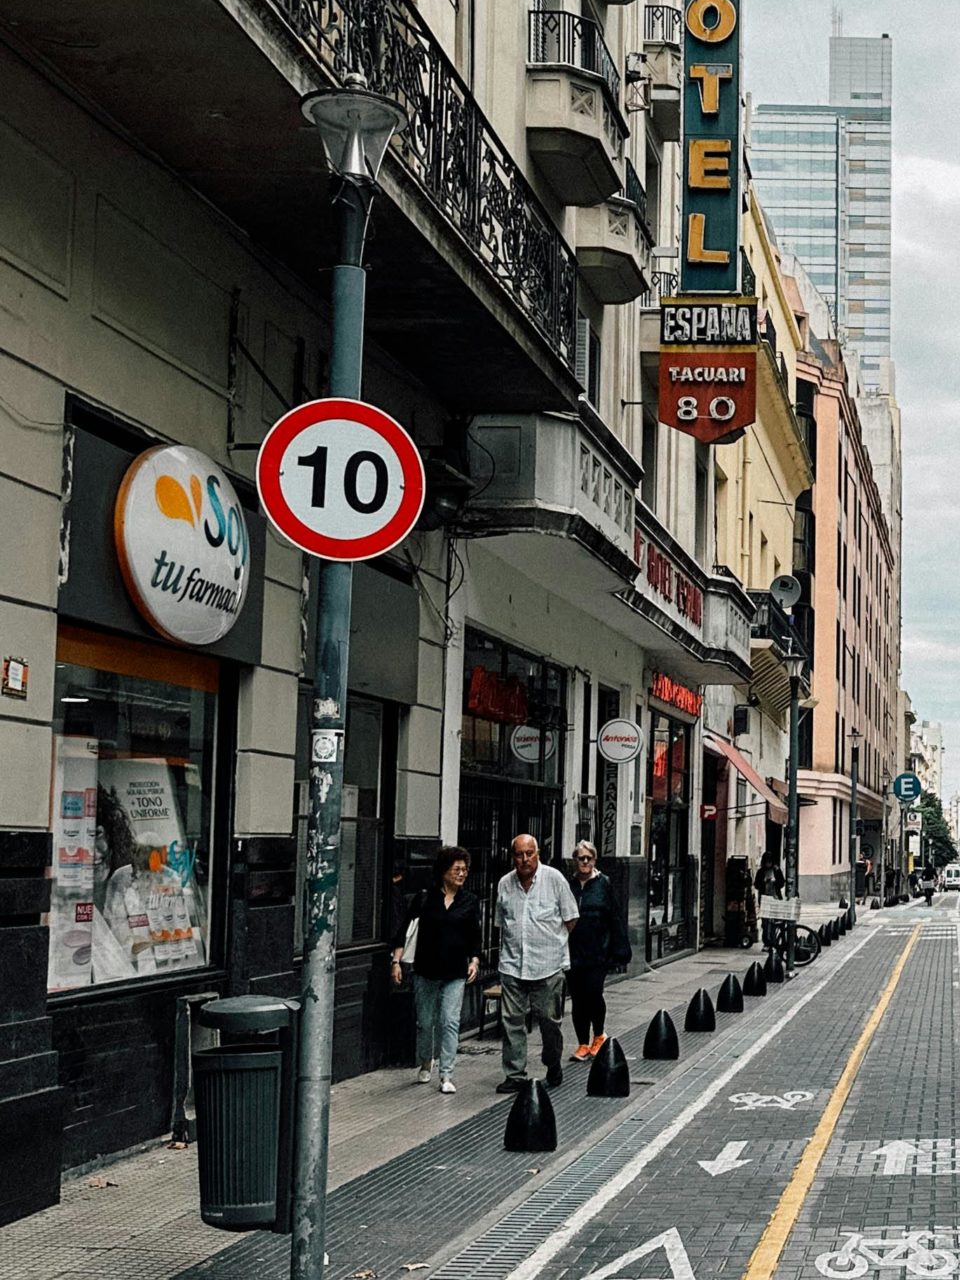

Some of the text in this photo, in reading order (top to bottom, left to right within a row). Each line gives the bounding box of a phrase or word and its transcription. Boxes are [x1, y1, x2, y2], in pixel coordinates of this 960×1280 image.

[663, 304, 752, 343] ESPAÑA
[668, 365, 746, 384] TACUARI
[676, 395, 737, 422] 80
[296, 444, 389, 516] 10
[204, 475, 248, 580] Soy
[151, 549, 185, 596] tu
[135, 796, 162, 808] TONO
[901, 778, 914, 795] E
